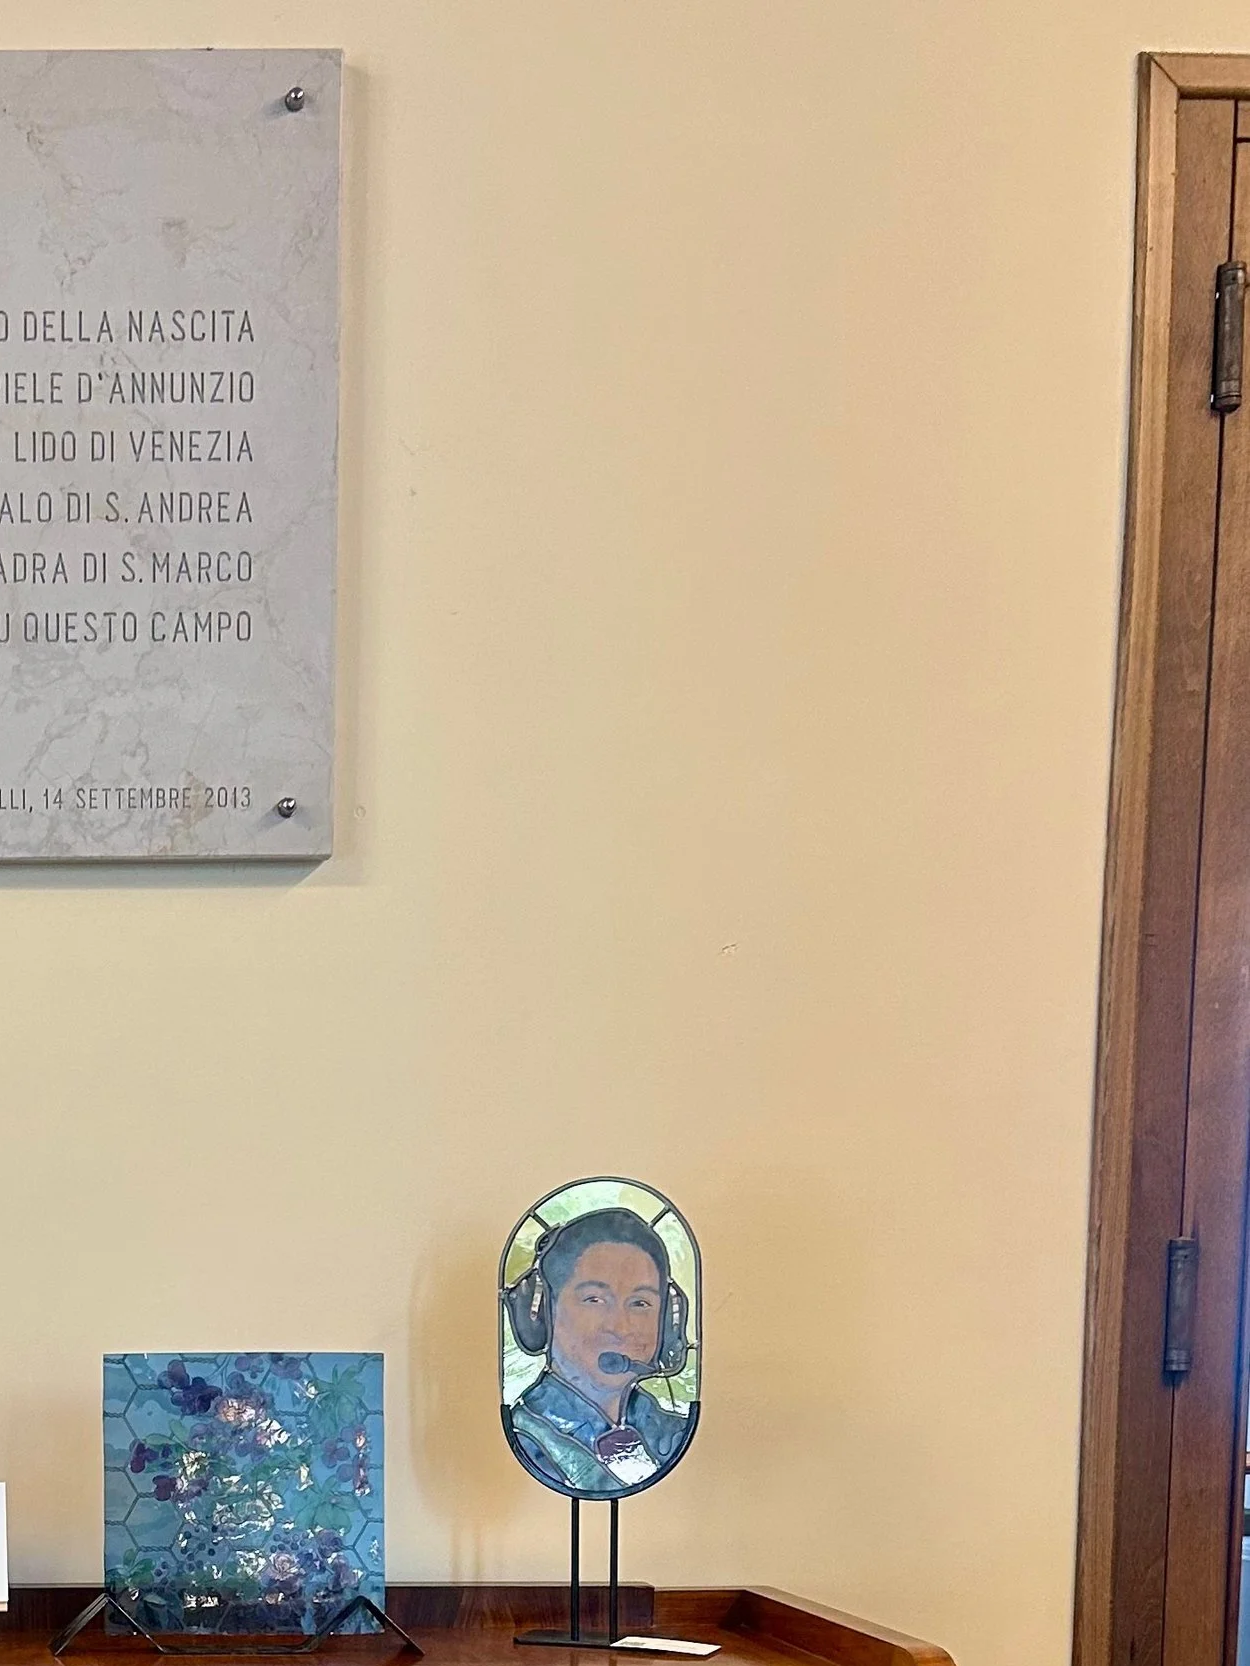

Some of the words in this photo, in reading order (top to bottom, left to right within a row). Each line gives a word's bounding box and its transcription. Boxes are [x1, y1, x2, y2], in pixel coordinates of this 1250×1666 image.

[23, 309, 114, 343] DELLA
[128, 309, 255, 343] NASCITA
[78, 370, 254, 405] D'ANNUNZIO
[14, 430, 77, 463] LIDO
[90, 430, 115, 463] DI
[129, 430, 254, 463] VENEZIA
[66, 491, 91, 524] DI
[83, 551, 107, 584] DI
[23, 611, 138, 644] QUESTO
[151, 610, 251, 644] CAMPO
[43, 787, 64, 810] 14
[75, 786, 192, 810] SETTEMBRE
[203, 786, 252, 809] 2013
